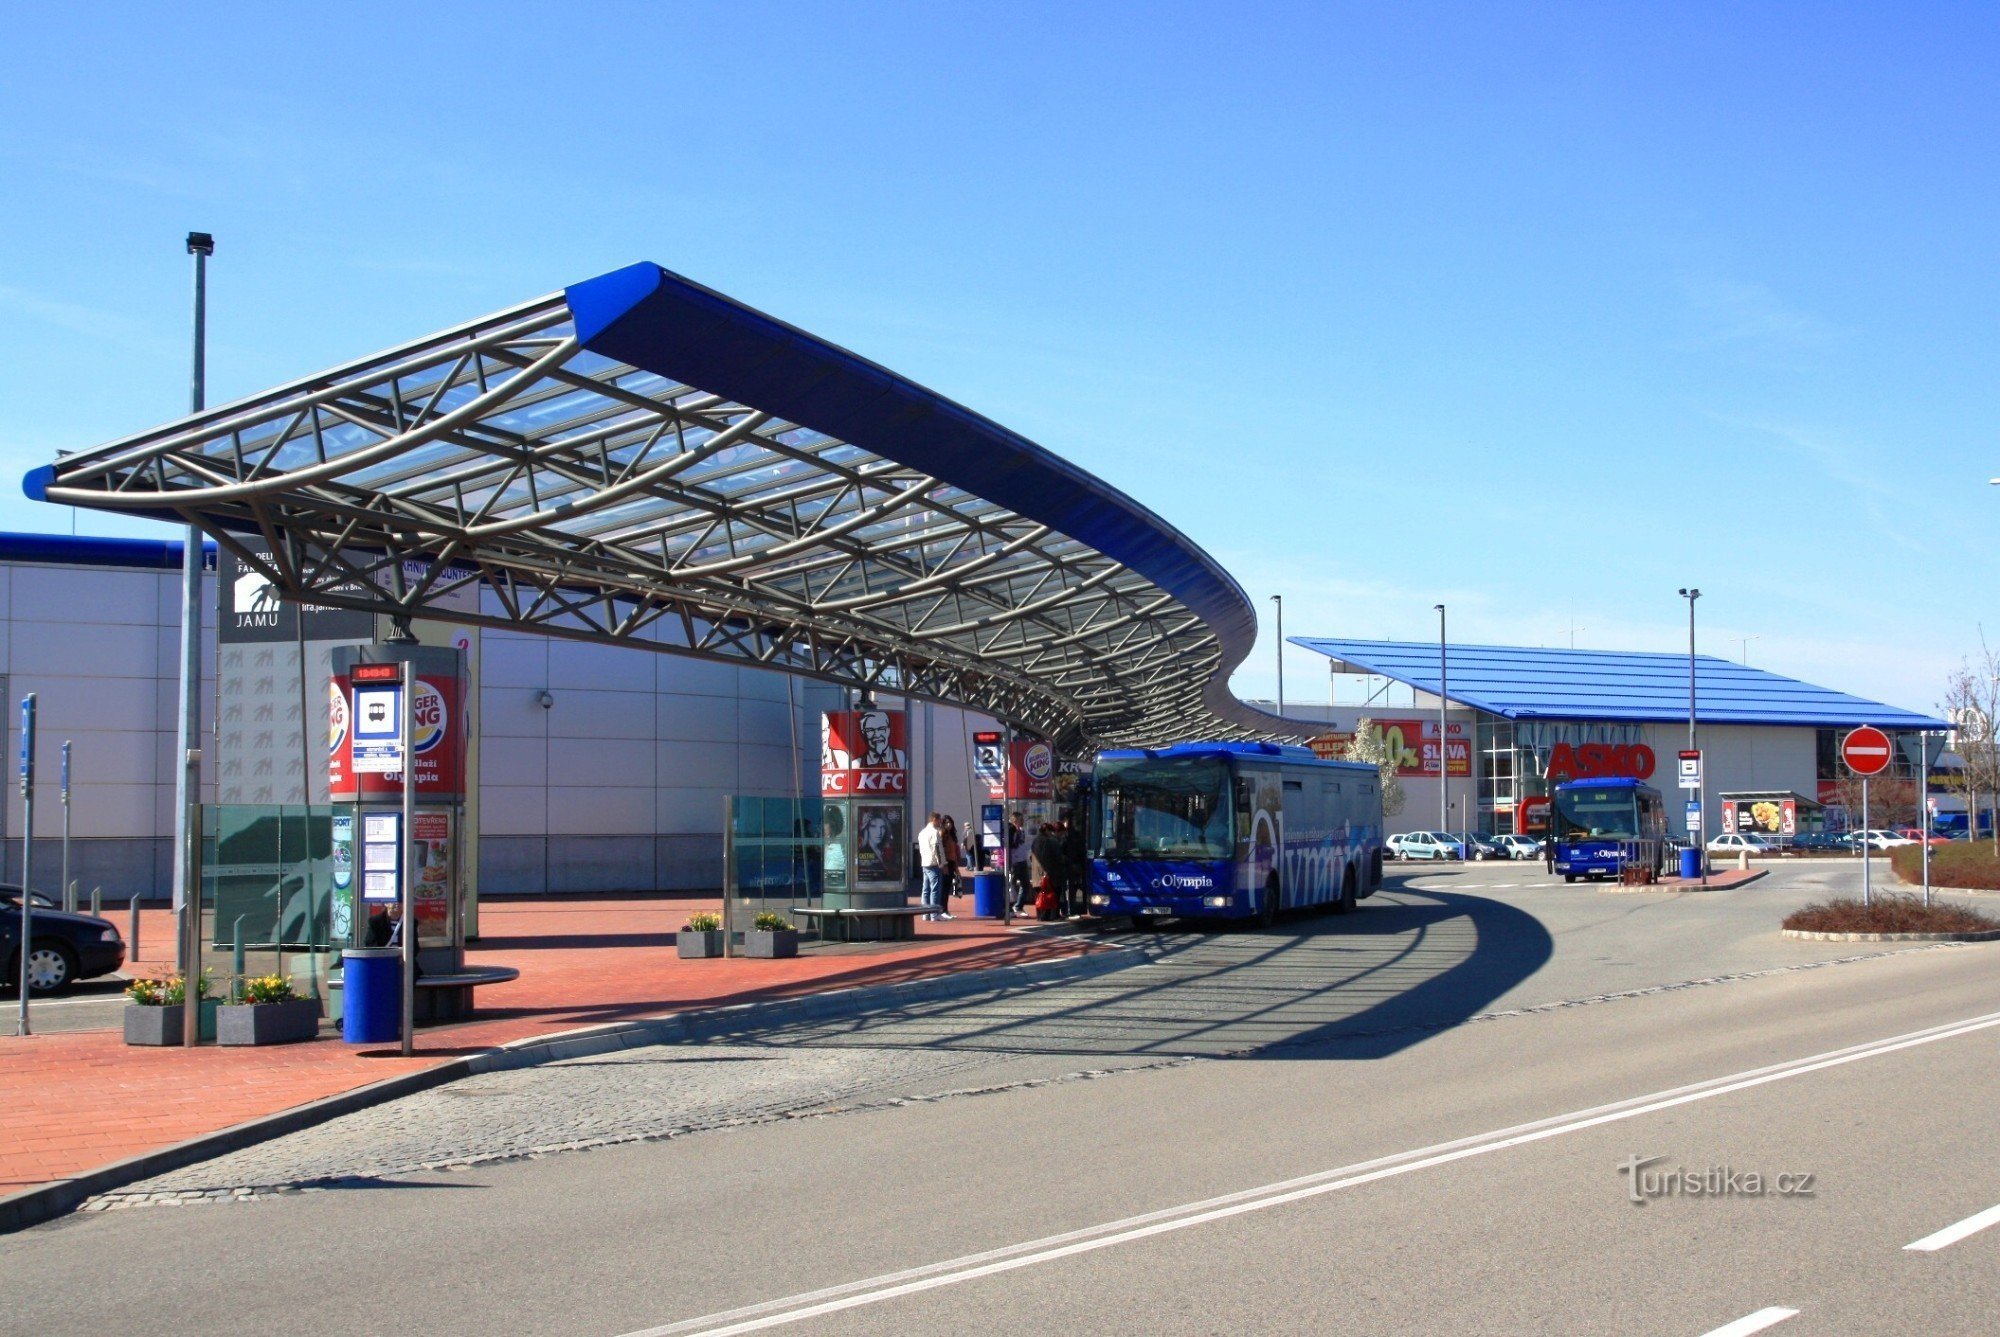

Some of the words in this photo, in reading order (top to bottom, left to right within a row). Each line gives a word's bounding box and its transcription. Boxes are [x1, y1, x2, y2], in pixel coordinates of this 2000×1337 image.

[236, 613, 278, 628] JAMU
[983, 749, 994, 763] 2
[1423, 744, 1466, 759] SLVA
[1547, 743, 1656, 780] ASKO
[857, 773, 904, 790] KFC
[1161, 874, 1214, 889] Olympia
